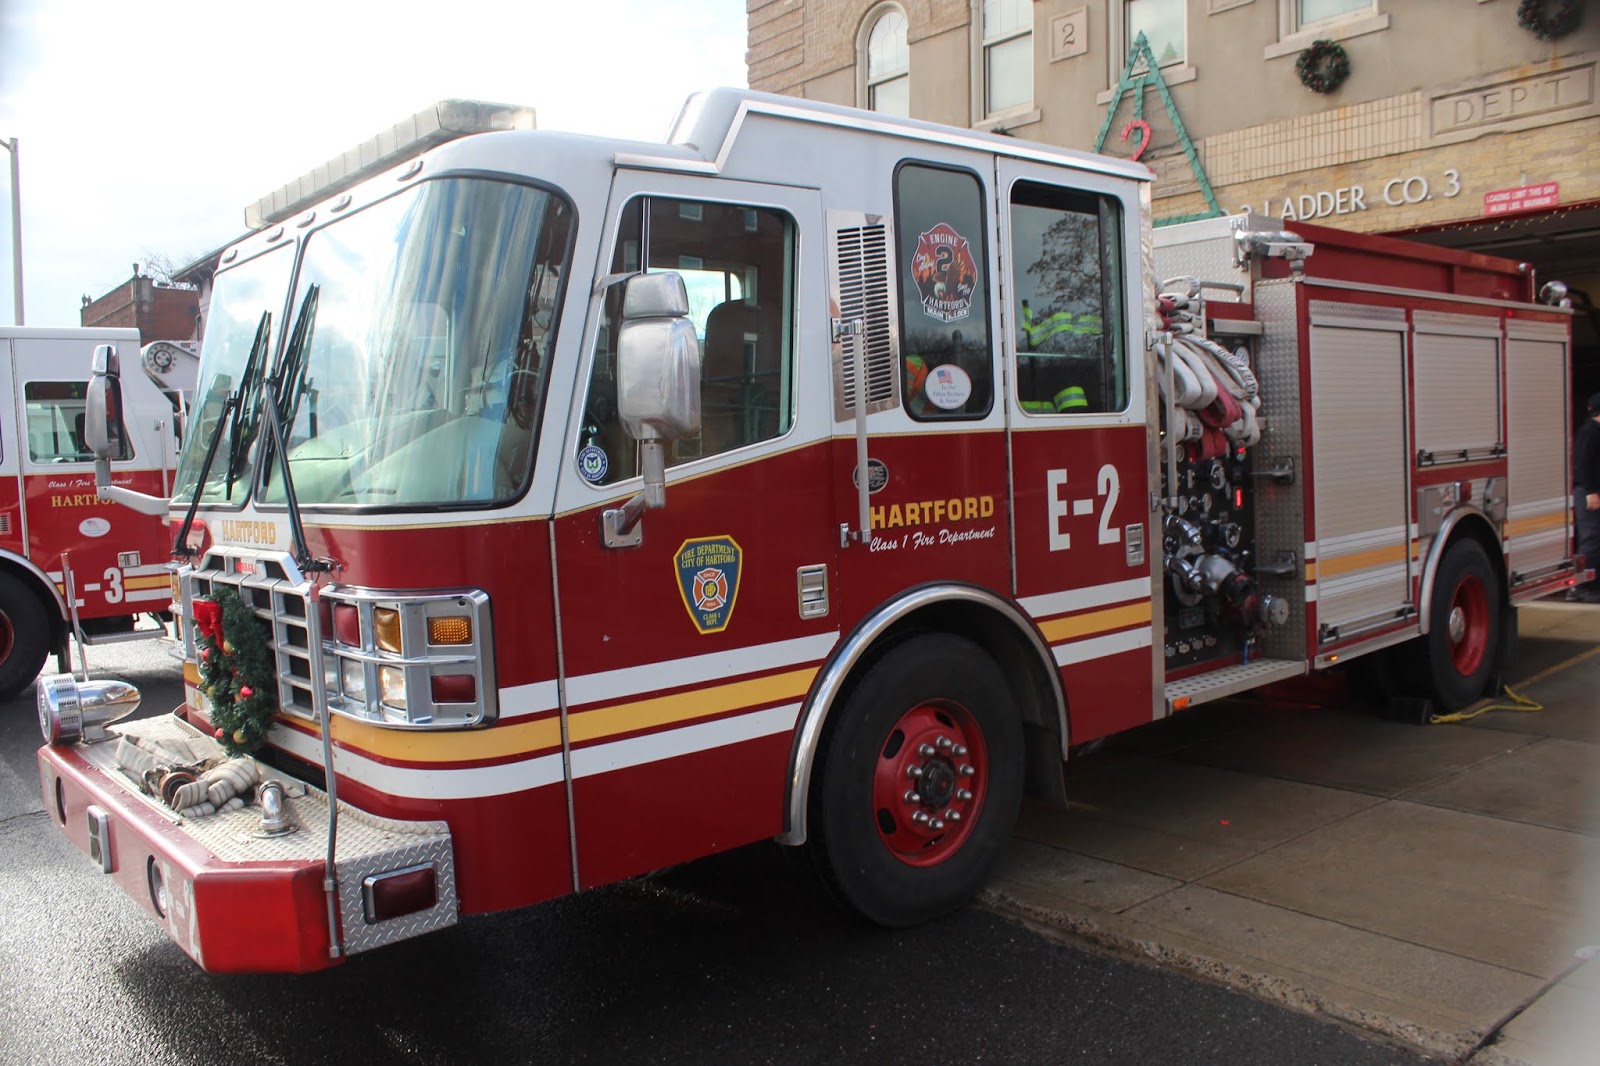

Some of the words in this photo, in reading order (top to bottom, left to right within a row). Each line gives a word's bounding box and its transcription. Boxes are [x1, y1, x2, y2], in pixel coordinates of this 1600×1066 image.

[1453, 76, 1571, 125] DEP'T
[1383, 175, 1432, 206] CO.
[1443, 169, 1461, 198] 3
[929, 233, 959, 247] ENGINE
[928, 296, 964, 310] HARTFORD
[48, 480, 67, 488] Class
[75, 479, 91, 488] Fire
[51, 494, 117, 507] HARTF
[1047, 463, 1121, 552] E-2
[870, 496, 995, 530] HARTFORD
[222, 519, 277, 545] HARTFORD
[869, 537, 899, 552] Class
[902, 534, 909, 549] 1
[912, 531, 935, 550] Fire
[938, 526, 995, 546] Department
[681, 548, 695, 560] FIRE
[697, 544, 734, 555] DEPARTMENT
[681, 558, 695, 568] CITY
[696, 557, 704, 567] OF
[705, 555, 735, 565] HARTFORD
